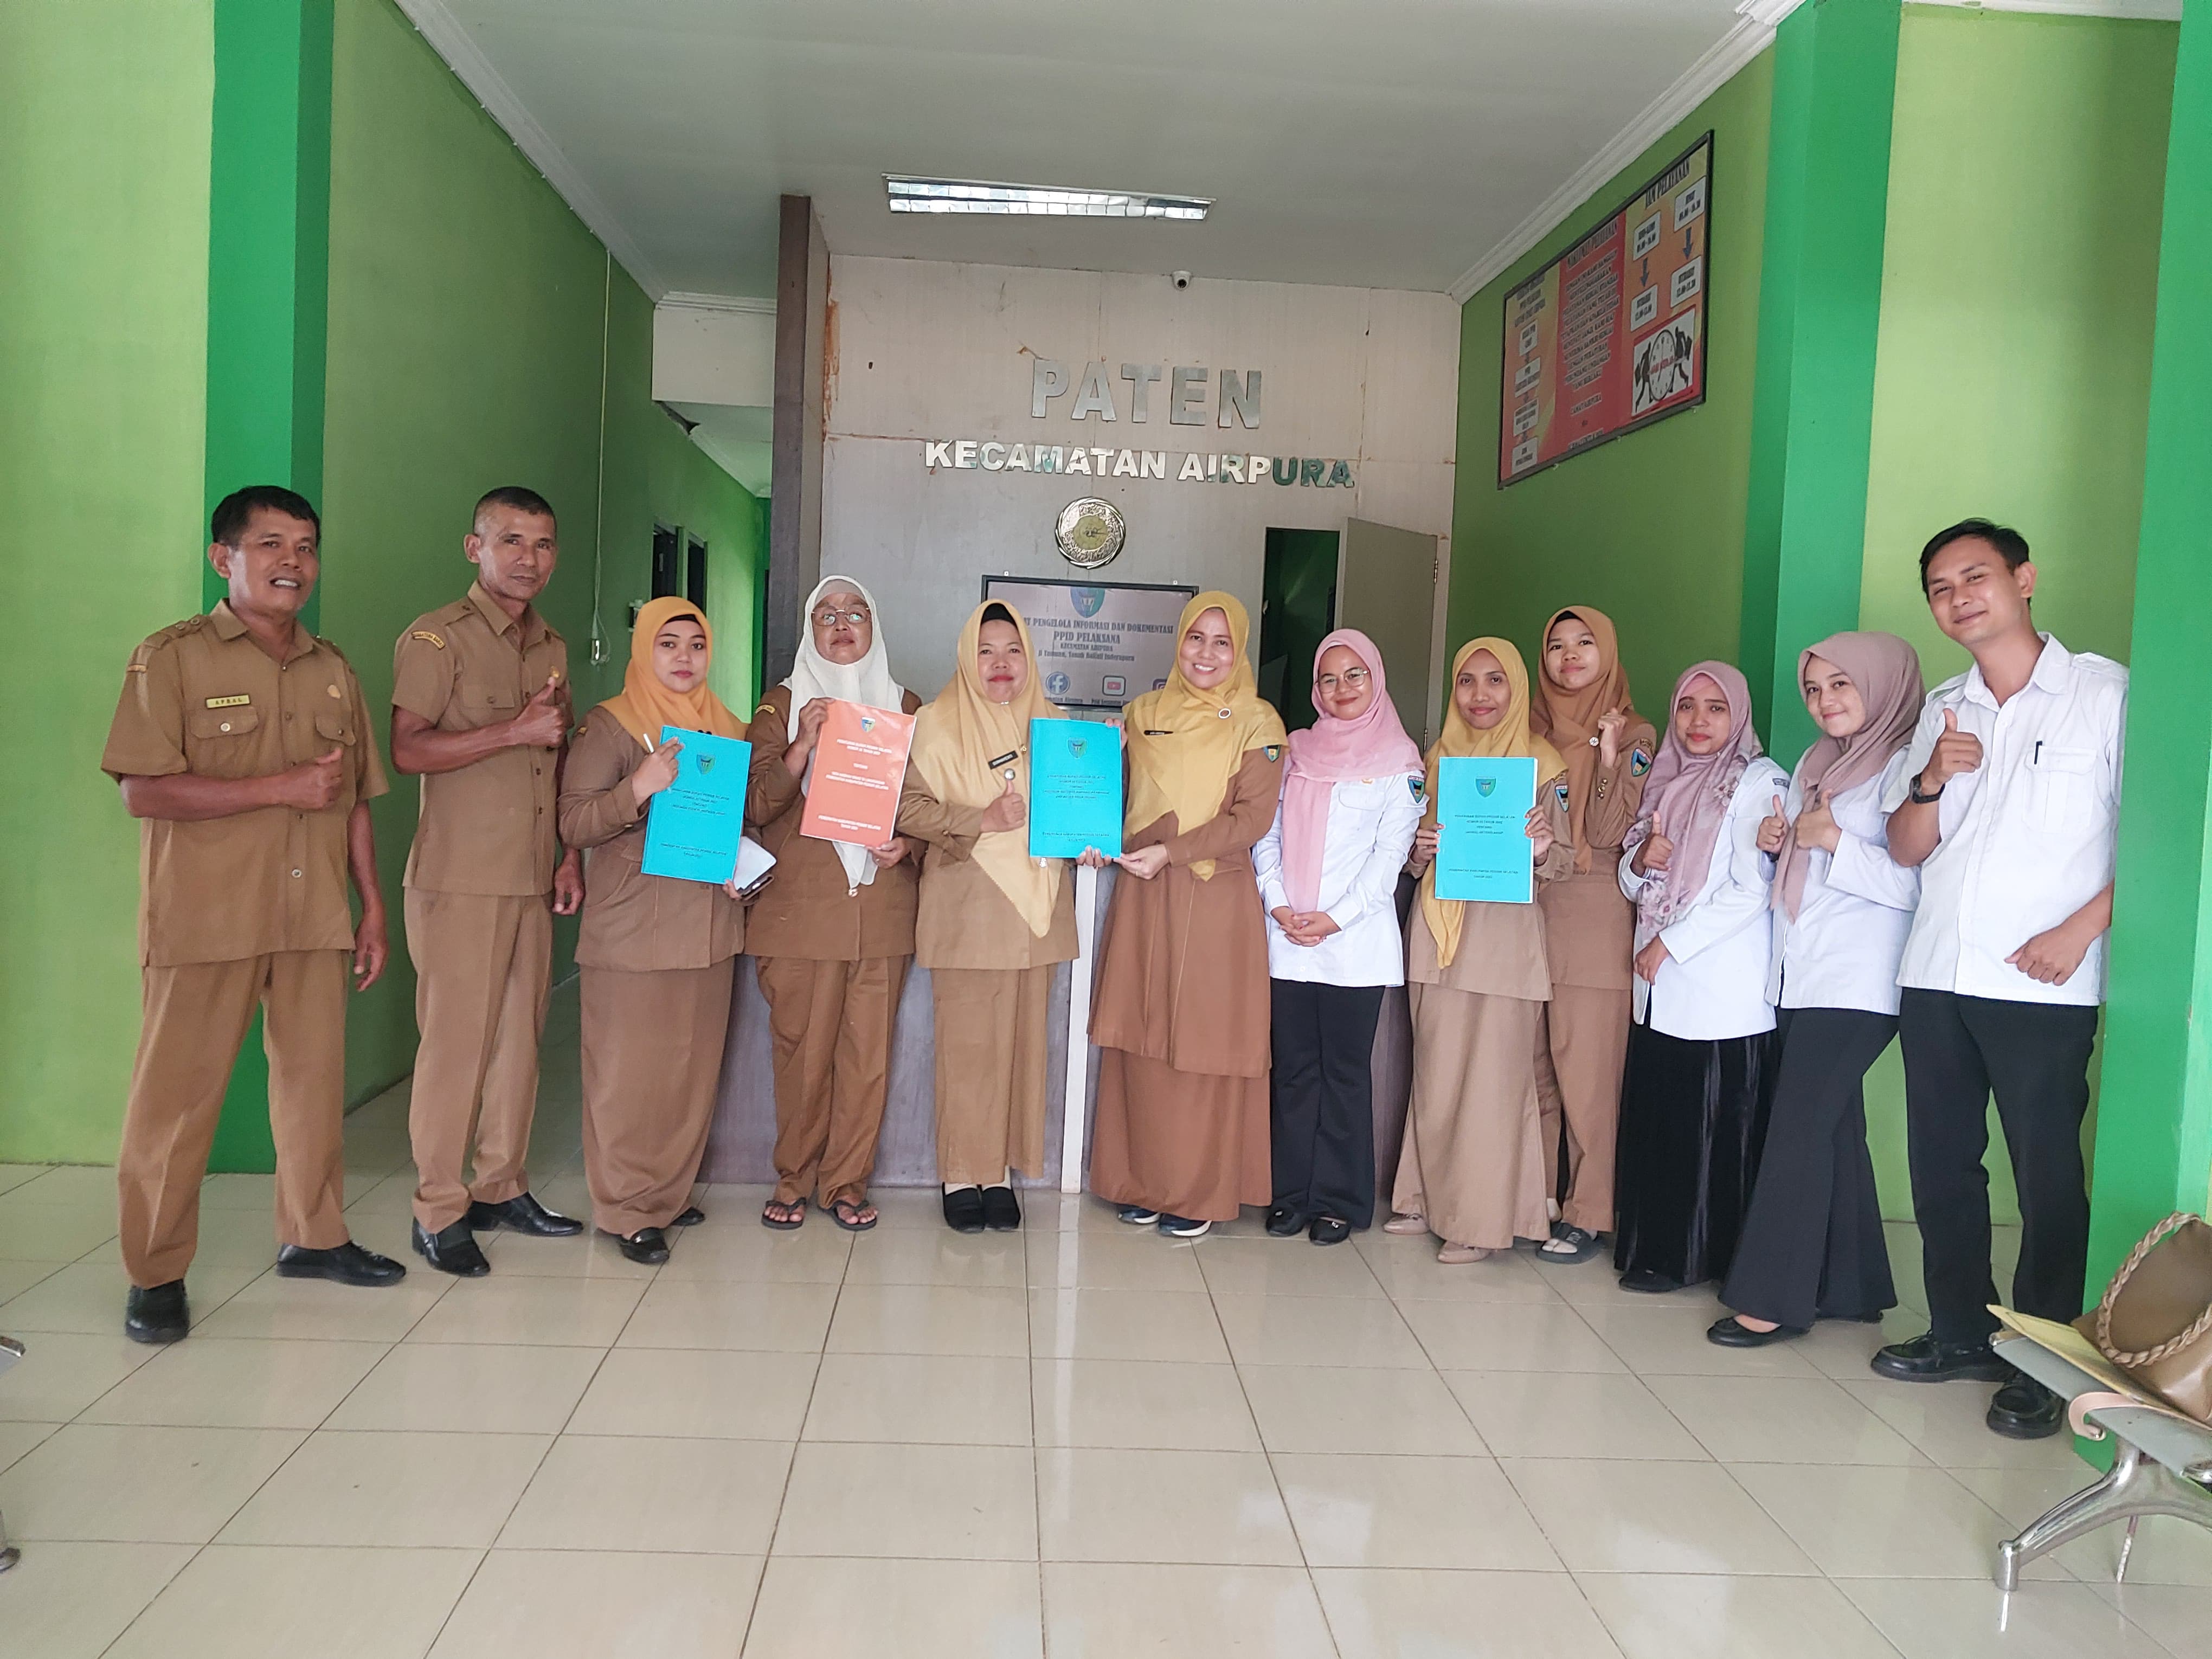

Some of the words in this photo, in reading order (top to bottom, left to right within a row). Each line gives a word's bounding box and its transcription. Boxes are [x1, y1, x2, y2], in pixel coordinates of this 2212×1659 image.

[1031, 359, 1262, 429] PATEN
[925, 440, 1166, 479] KECAMATAN
[1177, 453, 1355, 488] AIRPURA
[1033, 618, 1071, 628] PENGELOLA
[1073, 620, 1109, 630] INFORMASI
[1111, 622, 1126, 631] DAN
[1127, 623, 1173, 634] DOKUMENTASI
[1053, 631, 1074, 641] PPID
[1077, 632, 1120, 644] PELAKSANA
